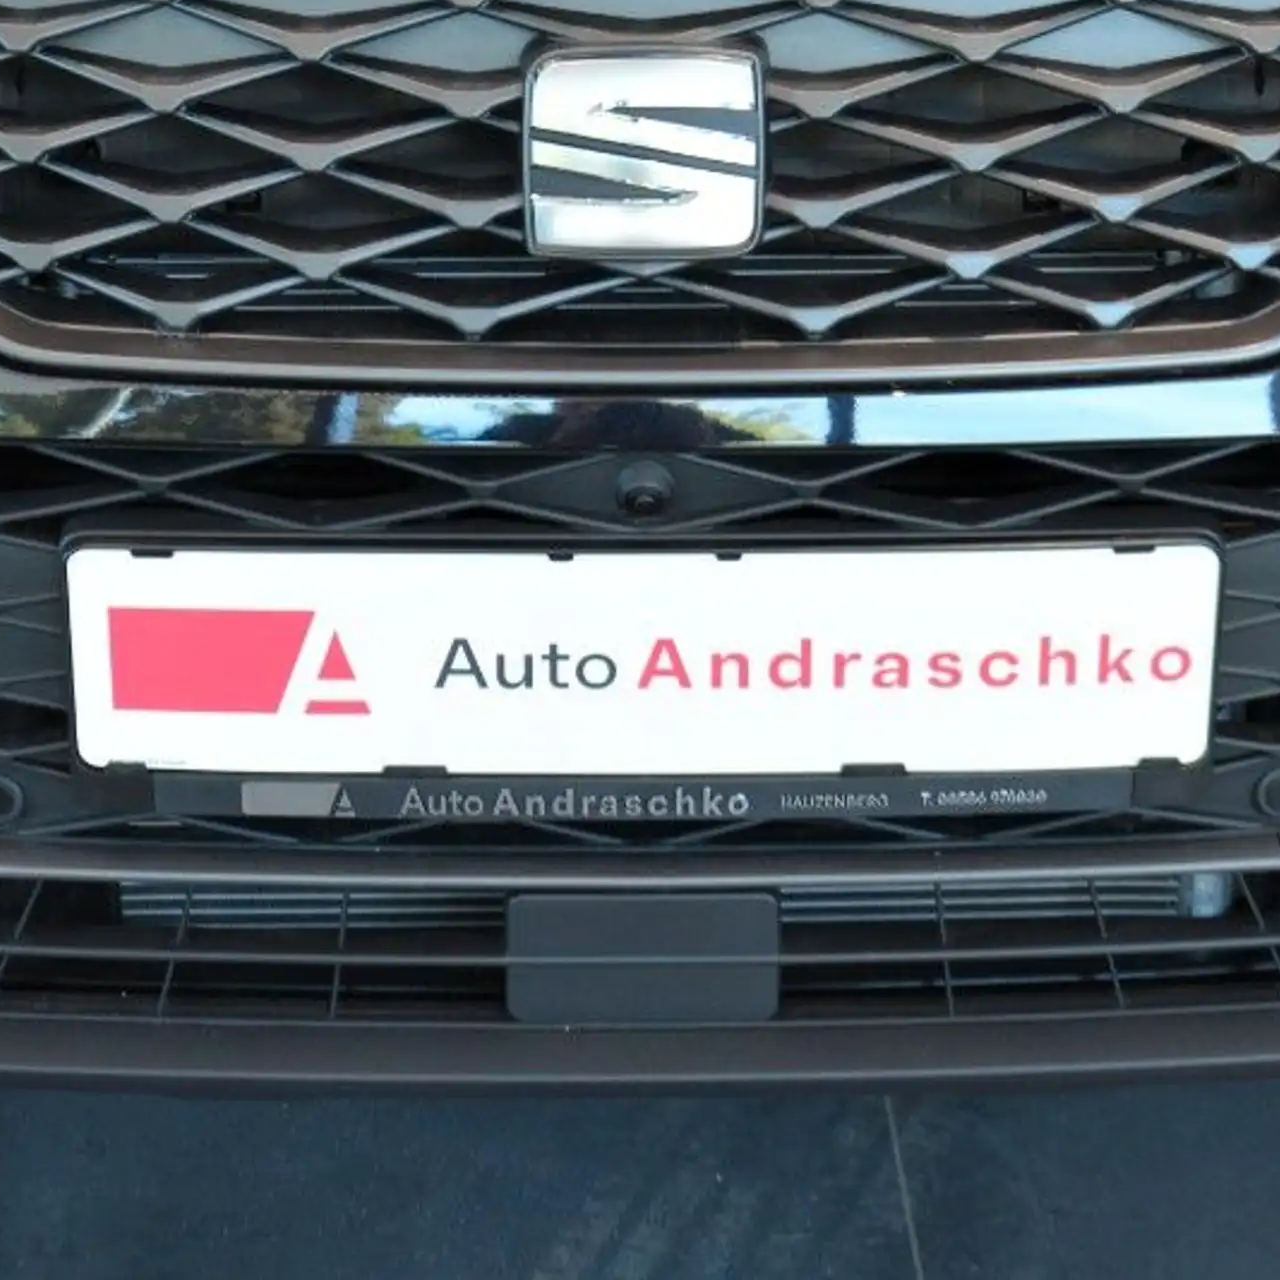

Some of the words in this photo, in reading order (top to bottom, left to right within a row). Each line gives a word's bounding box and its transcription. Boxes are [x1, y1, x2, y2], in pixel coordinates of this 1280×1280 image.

[434, 637, 617, 689] Auto
[637, 633, 1192, 689] Andraschko
[399, 787, 483, 818] Auto
[492, 786, 750, 817] Andraschko
